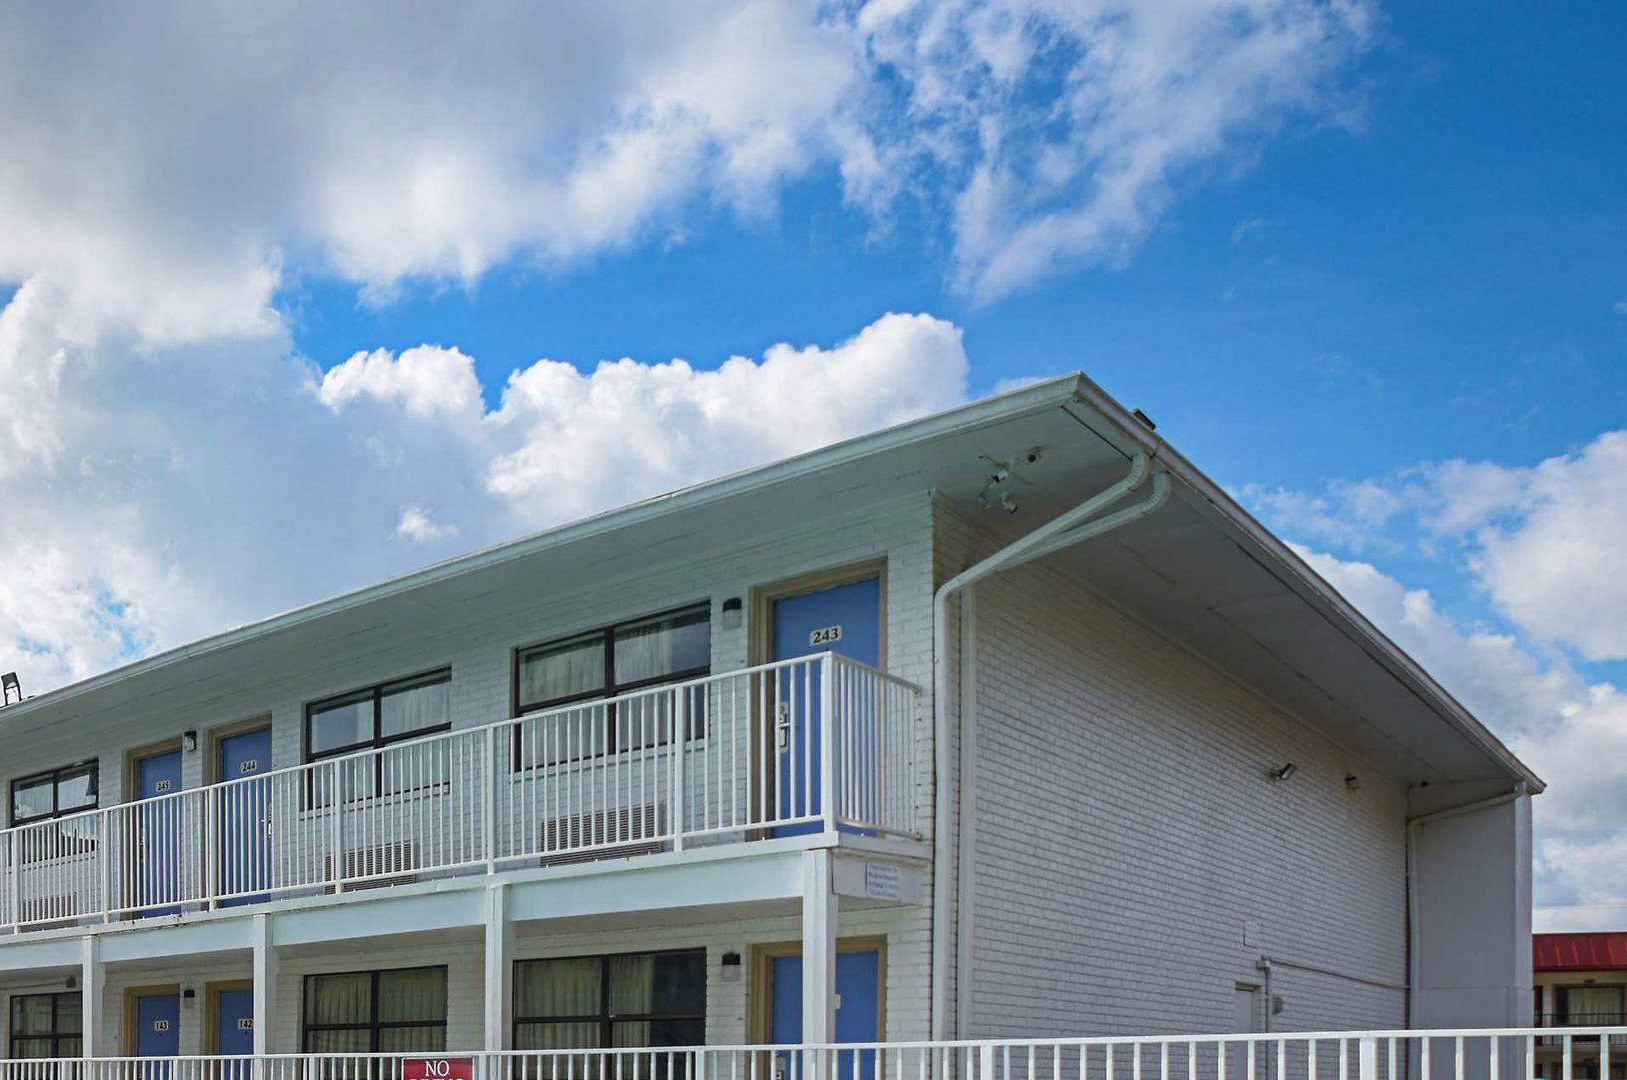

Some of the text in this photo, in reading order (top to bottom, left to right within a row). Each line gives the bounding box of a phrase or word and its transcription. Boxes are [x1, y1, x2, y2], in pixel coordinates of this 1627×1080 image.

[813, 628, 839, 644] 243
[242, 761, 256, 771] 244
[156, 1021, 168, 1030] 143
[239, 1019, 253, 1028] 142
[425, 1060, 449, 1077] NO
